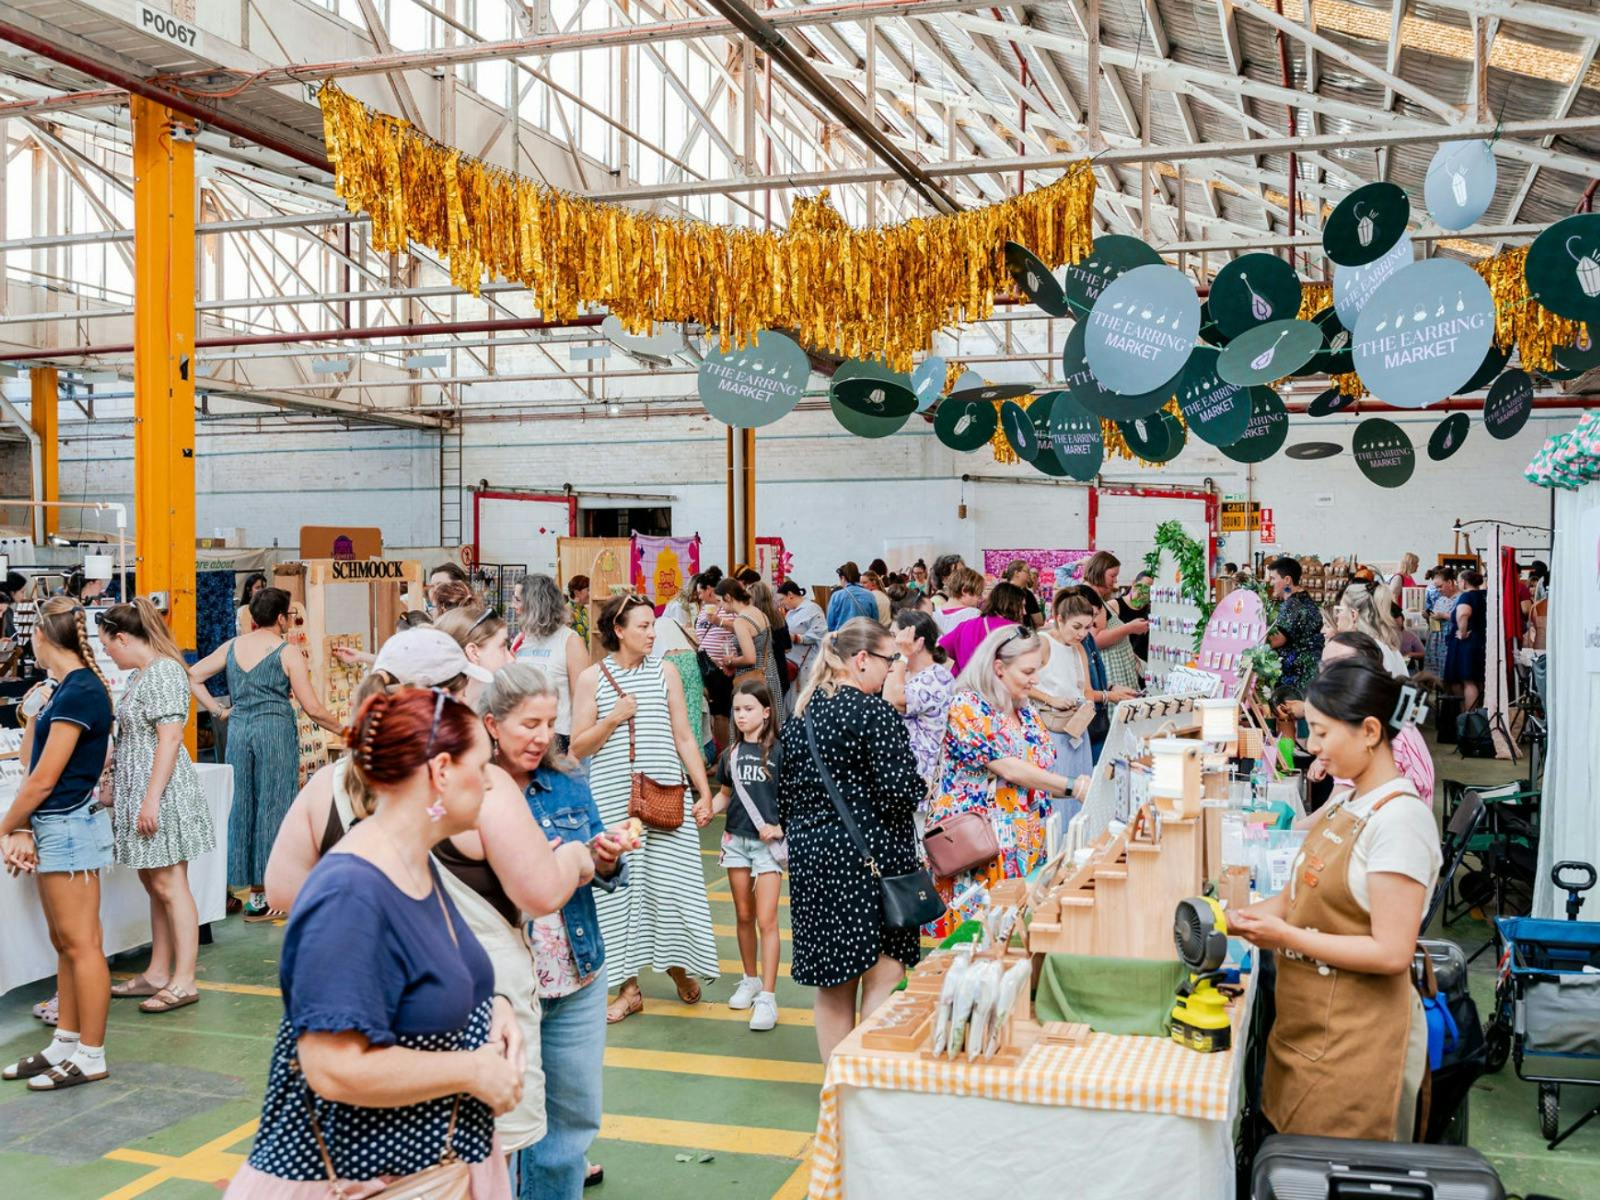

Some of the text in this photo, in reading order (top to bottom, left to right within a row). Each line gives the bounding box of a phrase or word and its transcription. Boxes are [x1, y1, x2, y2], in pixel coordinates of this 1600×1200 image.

[1073, 268, 1101, 287] THE
[1093, 311, 1187, 351] THE EARRING
[1359, 313, 1485, 357] THE EARRING
[1105, 332, 1162, 361] MARKET
[1384, 337, 1458, 369] MARKET
[706, 362, 798, 396] THE EARRING
[1070, 368, 1095, 386] TH
[718, 379, 775, 402] MARKET
[1182, 402, 1203, 417] THE
[1199, 397, 1235, 423] MARKET
[1248, 413, 1284, 428] RRING
[1053, 432, 1099, 444] THE EARRING
[1242, 425, 1271, 439] RKET
[1063, 444, 1091, 454] MARKET
[210, 560, 235, 569] about
[332, 561, 403, 579] SCHMOOCK
[737, 764, 767, 782] ARIS
